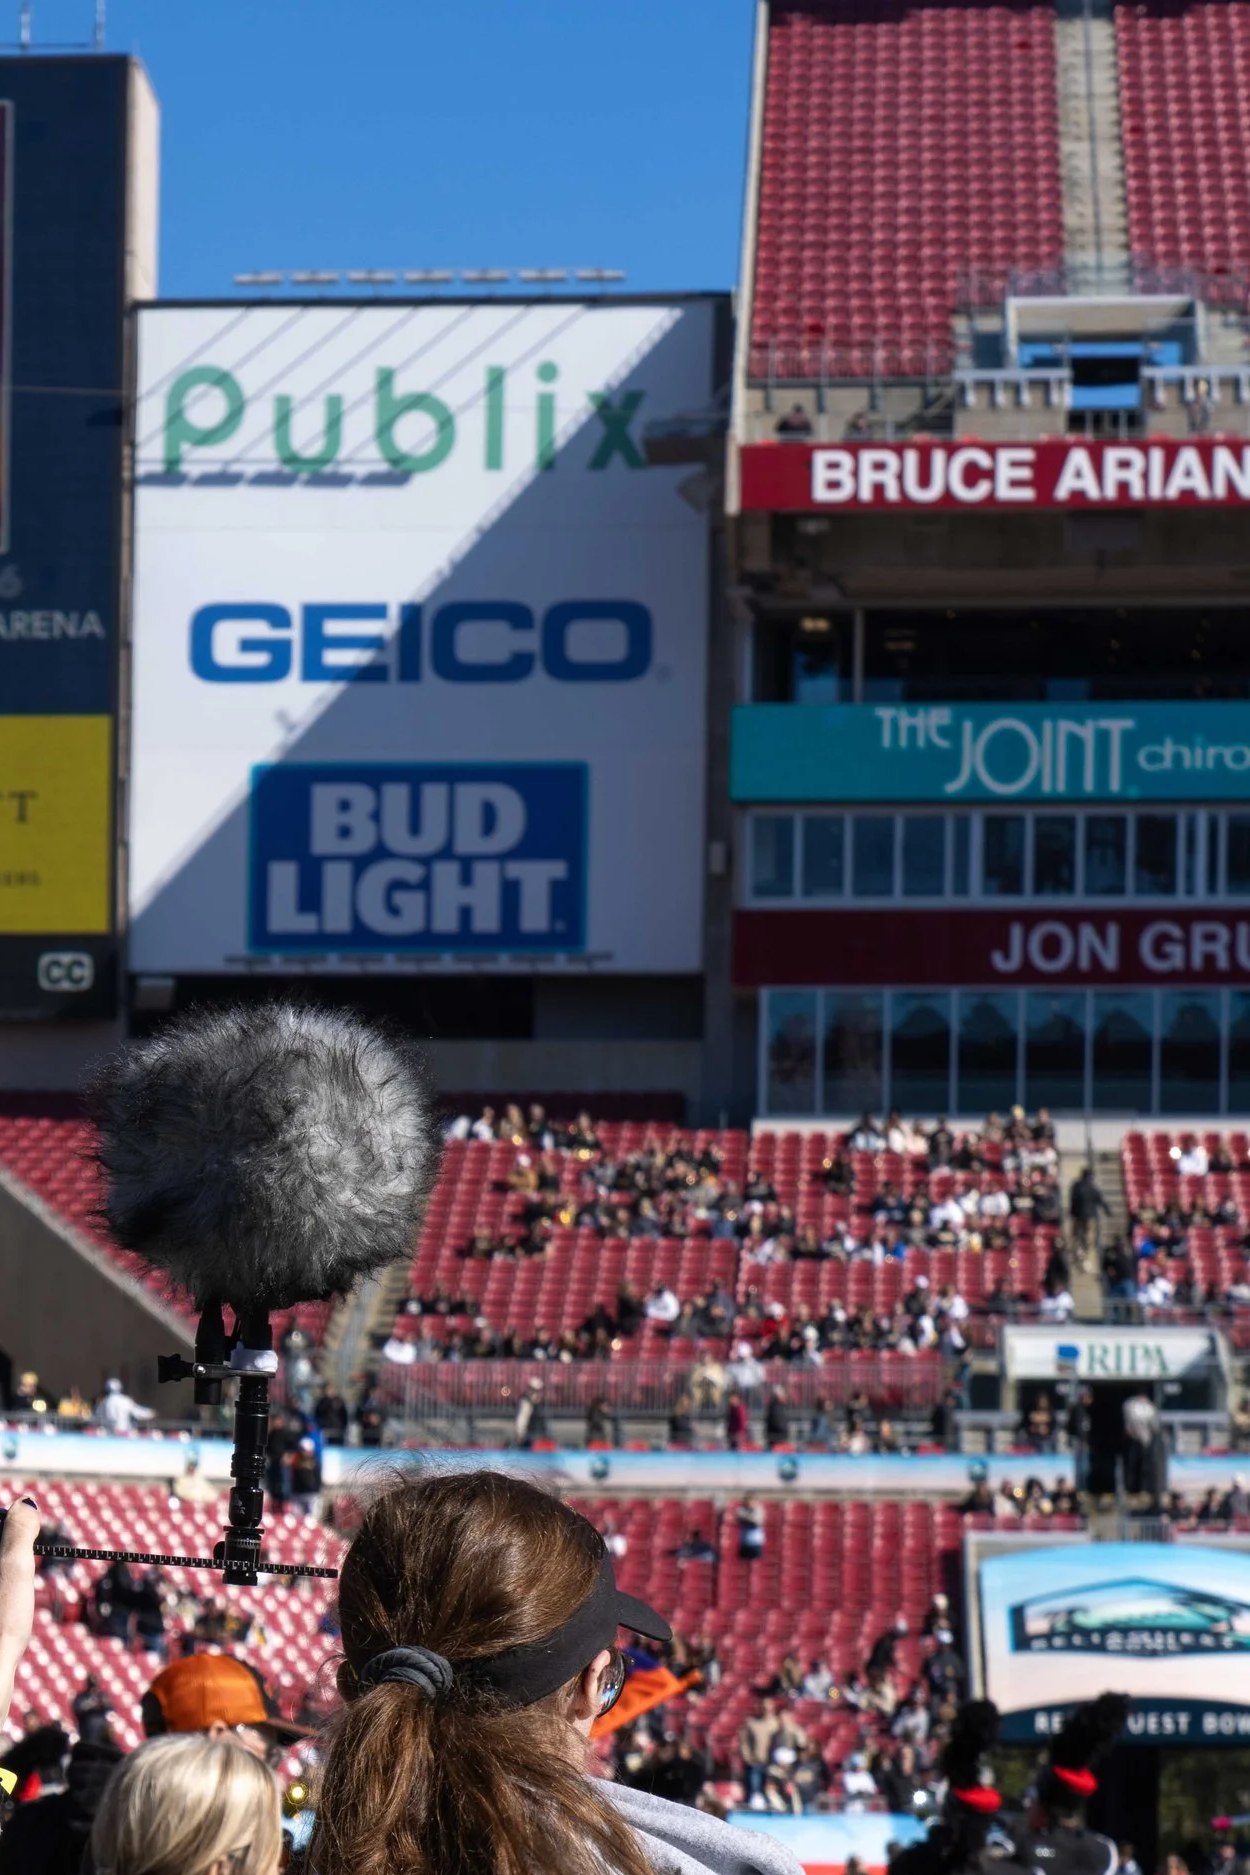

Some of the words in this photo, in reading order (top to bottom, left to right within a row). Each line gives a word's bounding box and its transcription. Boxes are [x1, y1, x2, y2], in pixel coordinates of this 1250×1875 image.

[162, 361, 648, 474] Publix
[810, 447, 1037, 502] BRUCE
[1053, 445, 1250, 501] ARIAN
[188, 601, 654, 685] GEICO
[874, 706, 952, 749] THE
[944, 717, 1136, 794] JOINT
[1137, 736, 1250, 772] chiro
[310, 782, 528, 857] BUD
[266, 860, 569, 936] LIGHT
[45, 957, 88, 987] CC
[990, 920, 1121, 973] JON
[1139, 920, 1250, 973] GR
[1087, 1342, 1171, 1373] RIPA
[1034, 1711, 1192, 1735] REUEST
